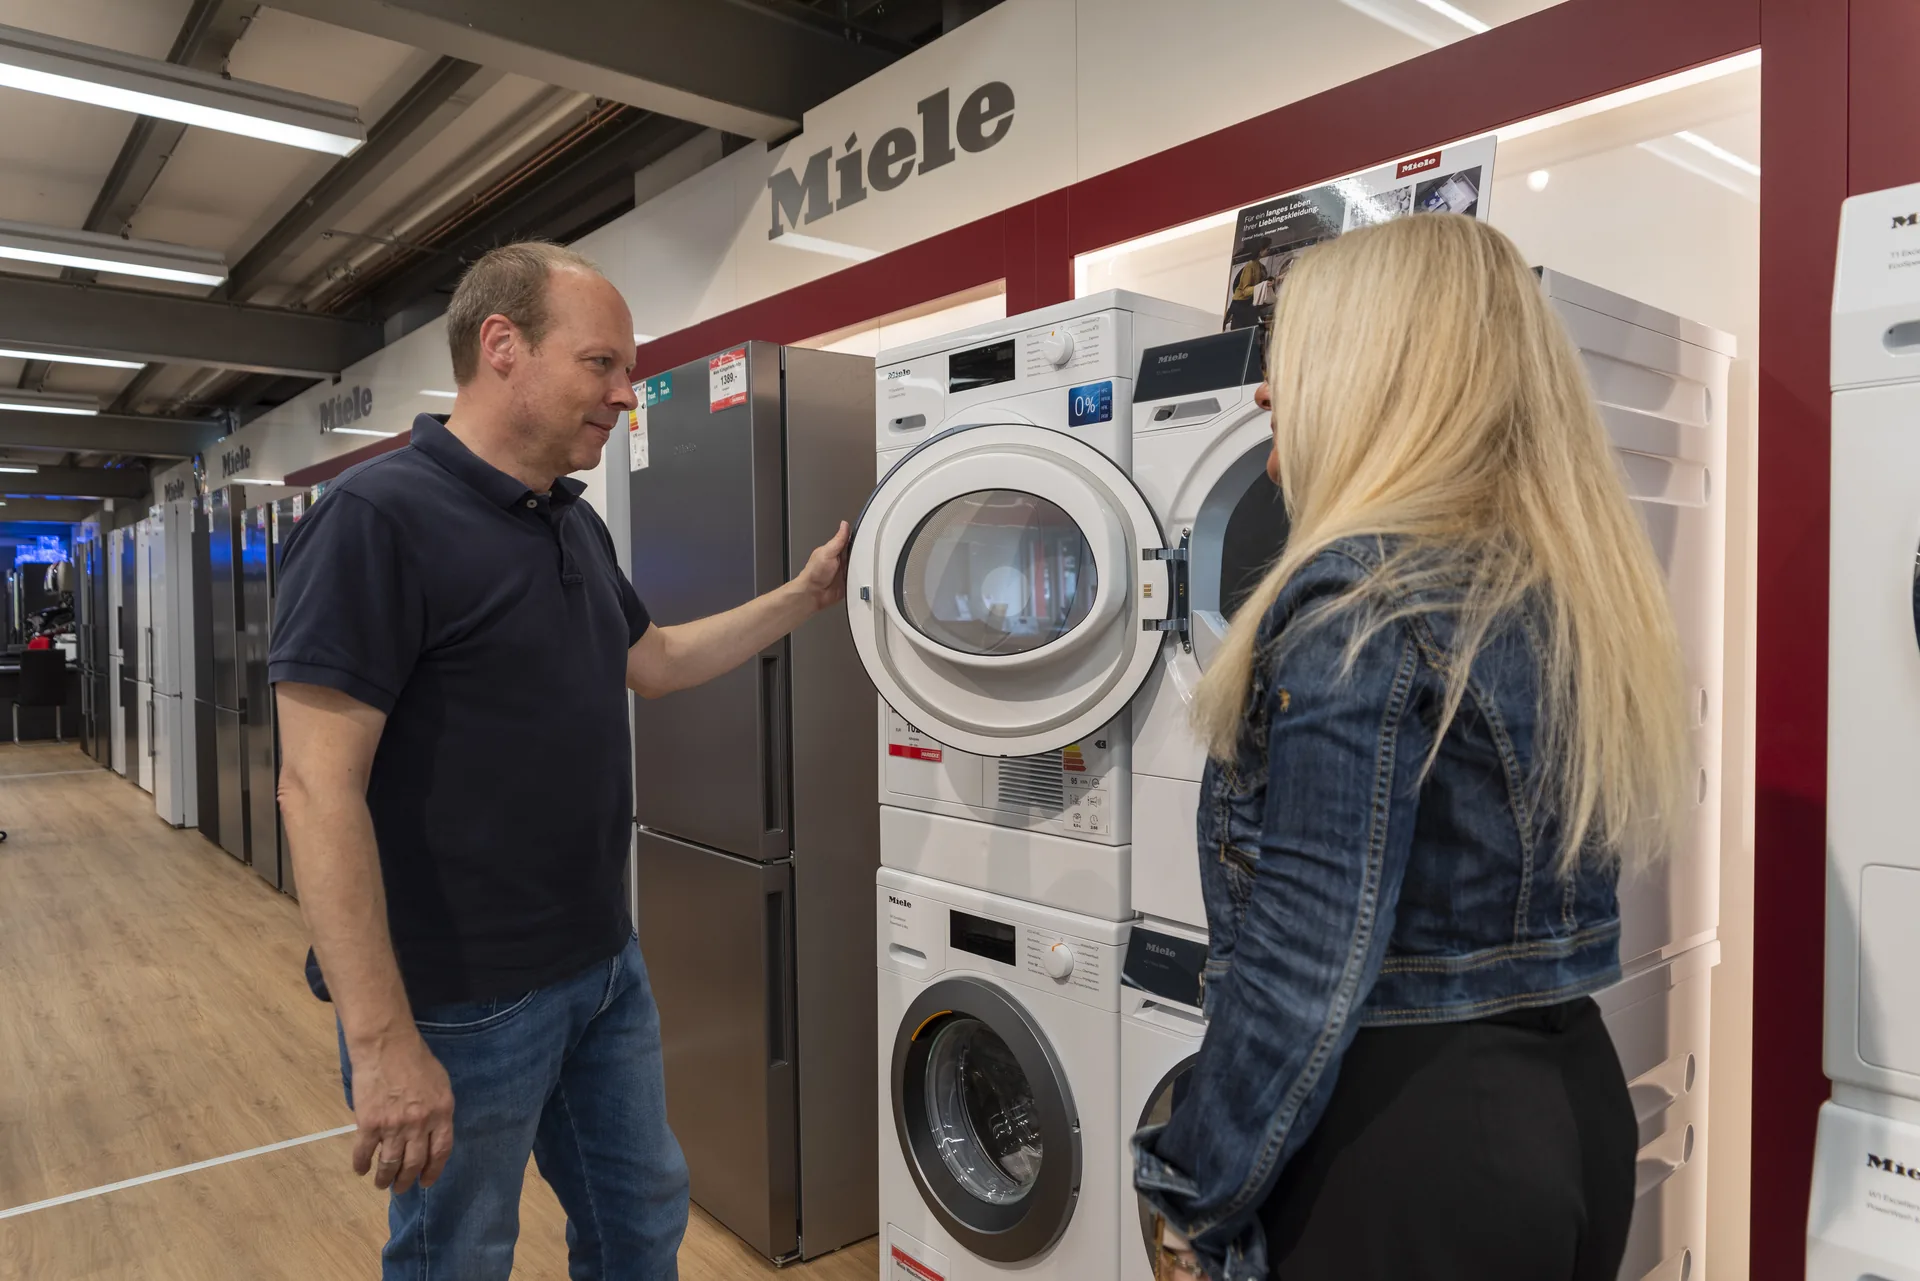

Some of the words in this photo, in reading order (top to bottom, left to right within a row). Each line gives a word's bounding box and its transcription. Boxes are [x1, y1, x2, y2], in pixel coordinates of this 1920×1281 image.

[767, 81, 1015, 241] Miele
[1401, 158, 1436, 172] Miele
[1243, 223, 1257, 232] Ihrer
[1258, 205, 1320, 228] Lieblingskleidung.
[1244, 214, 1255, 223] Für
[1255, 212, 1266, 220] ein
[1265, 205, 1288, 217] langes
[1289, 199, 1311, 210] Leben
[1891, 213, 1920, 229] M
[1158, 351, 1188, 364] Miele
[887, 368, 911, 380] Miele
[319, 384, 373, 435] Miele
[222, 445, 251, 478] Miele
[888, 895, 912, 909] Miele
[1145, 942, 1176, 957] Miele
